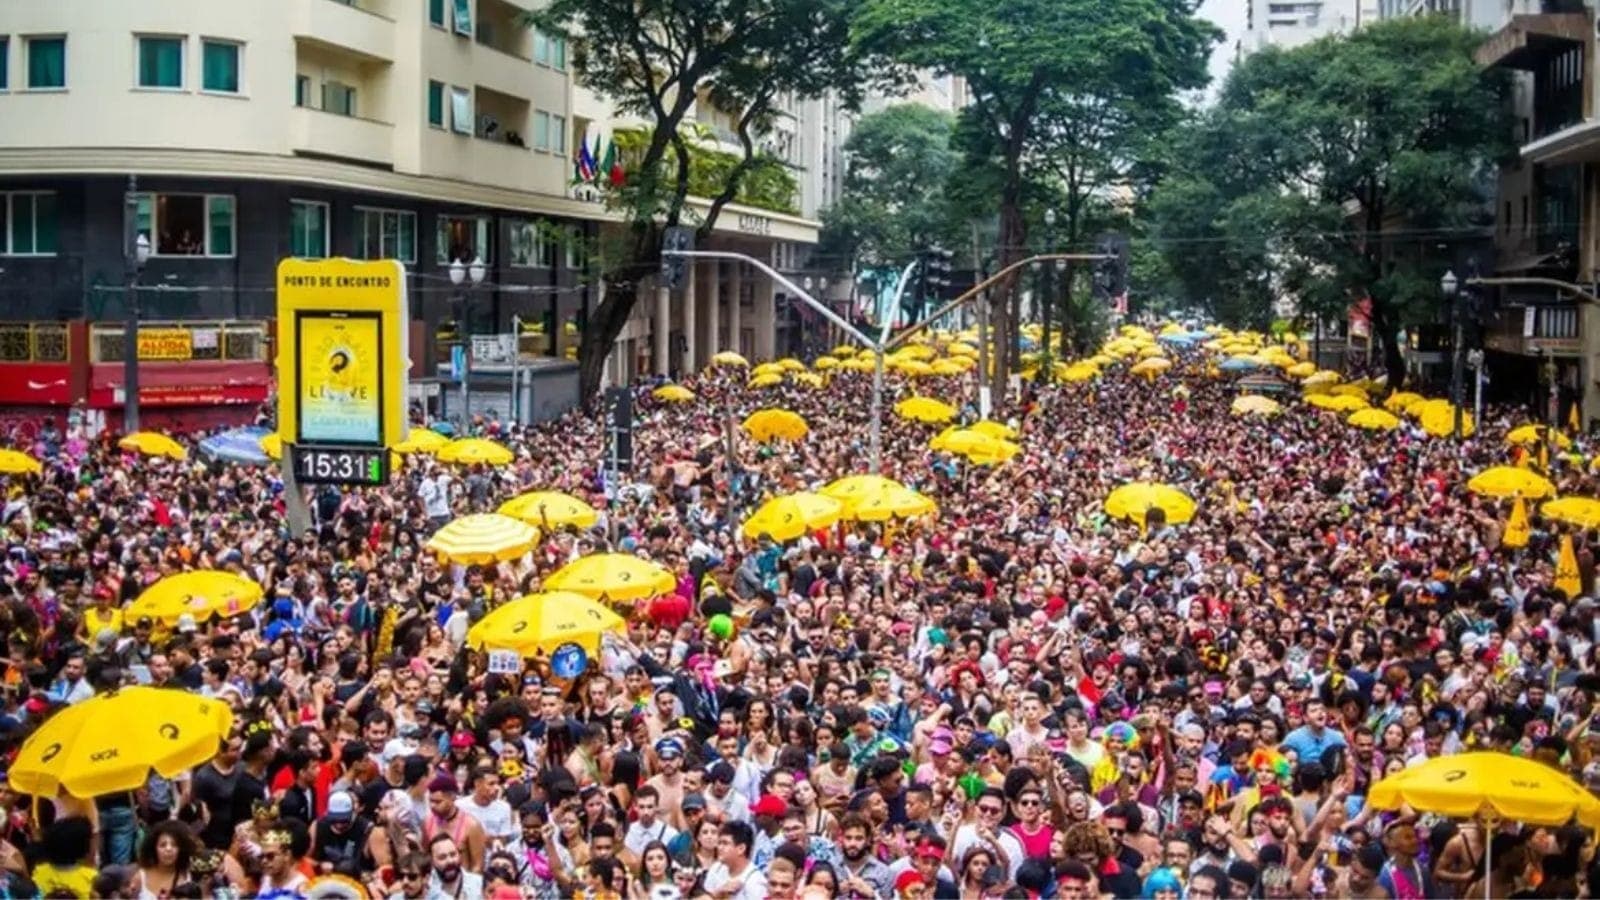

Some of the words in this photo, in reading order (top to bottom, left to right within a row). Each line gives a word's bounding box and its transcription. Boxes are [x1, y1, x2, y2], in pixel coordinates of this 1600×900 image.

[284, 275, 317, 288] PONTO
[319, 276, 333, 288] DE
[336, 276, 391, 288] ENCONTRO
[302, 453, 365, 479] 15:31
